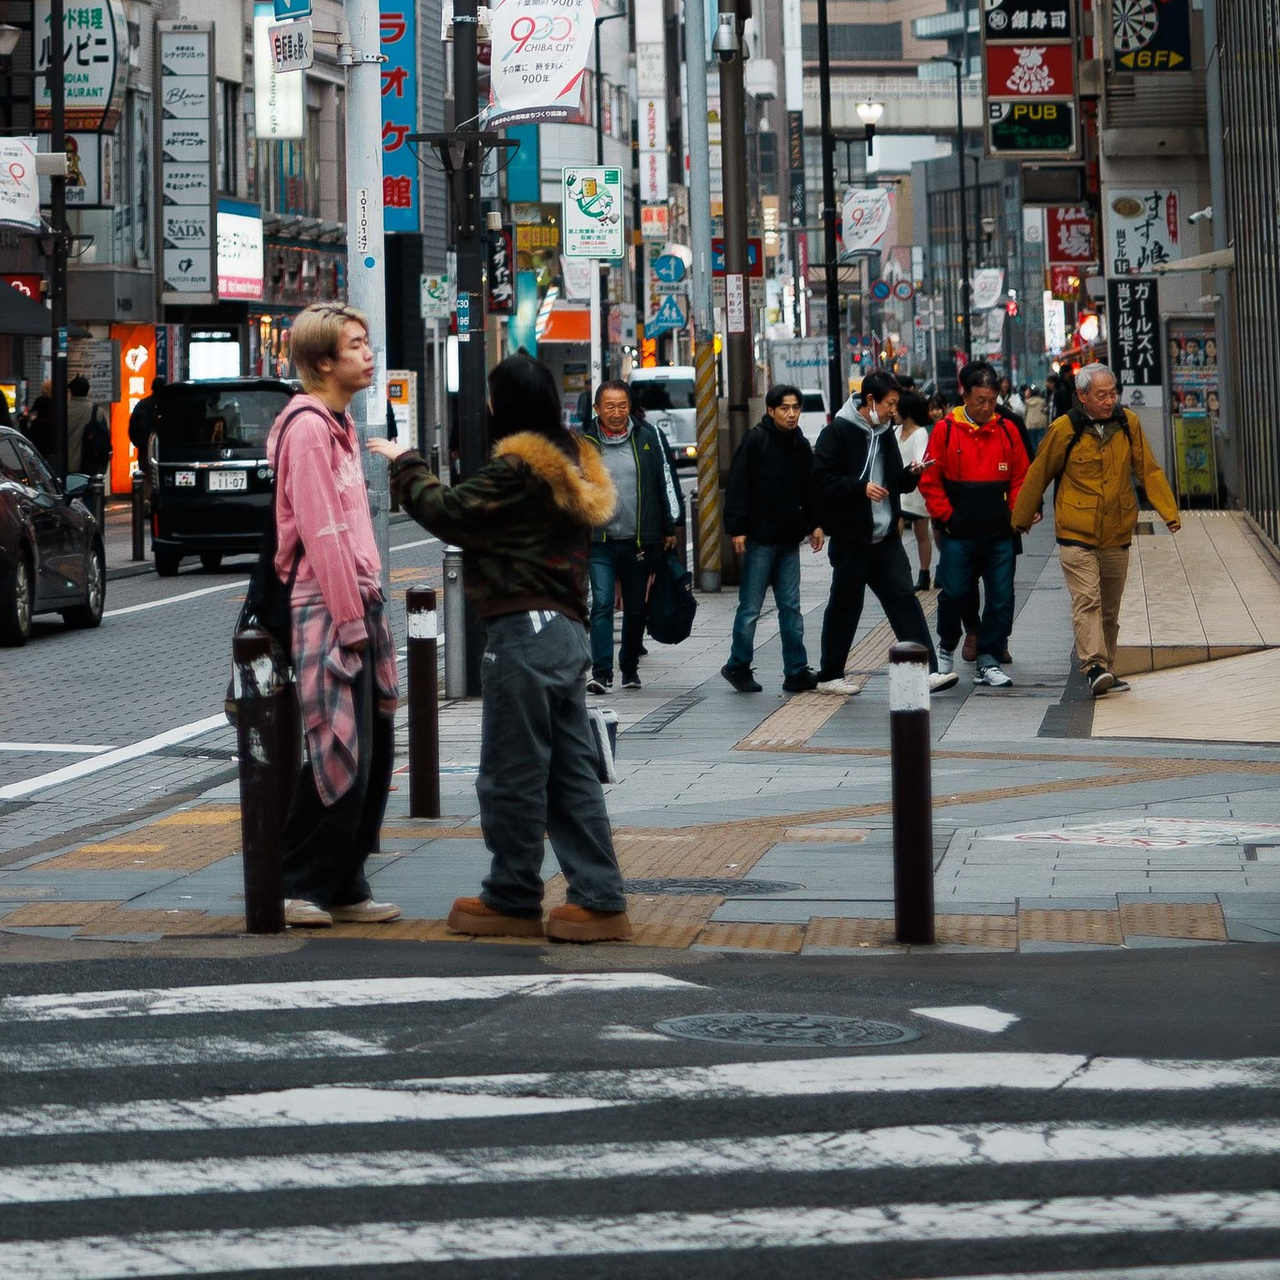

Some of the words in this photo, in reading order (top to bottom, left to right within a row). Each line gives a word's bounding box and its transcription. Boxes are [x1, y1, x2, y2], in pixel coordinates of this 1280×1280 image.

[524, 43, 553, 53] CHIBA
[555, 43, 574, 52] CITY
[1137, 50, 1169, 67] 6F
[521, 73, 550, 84] 900年
[1013, 104, 1058, 120] PUB
[360, 190, 368, 251] 101-0147
[166, 224, 206, 237] SADA
[1117, 283, 1136, 385] 当ビル地下1階
[1134, 281, 1155, 384] ガールズバー
